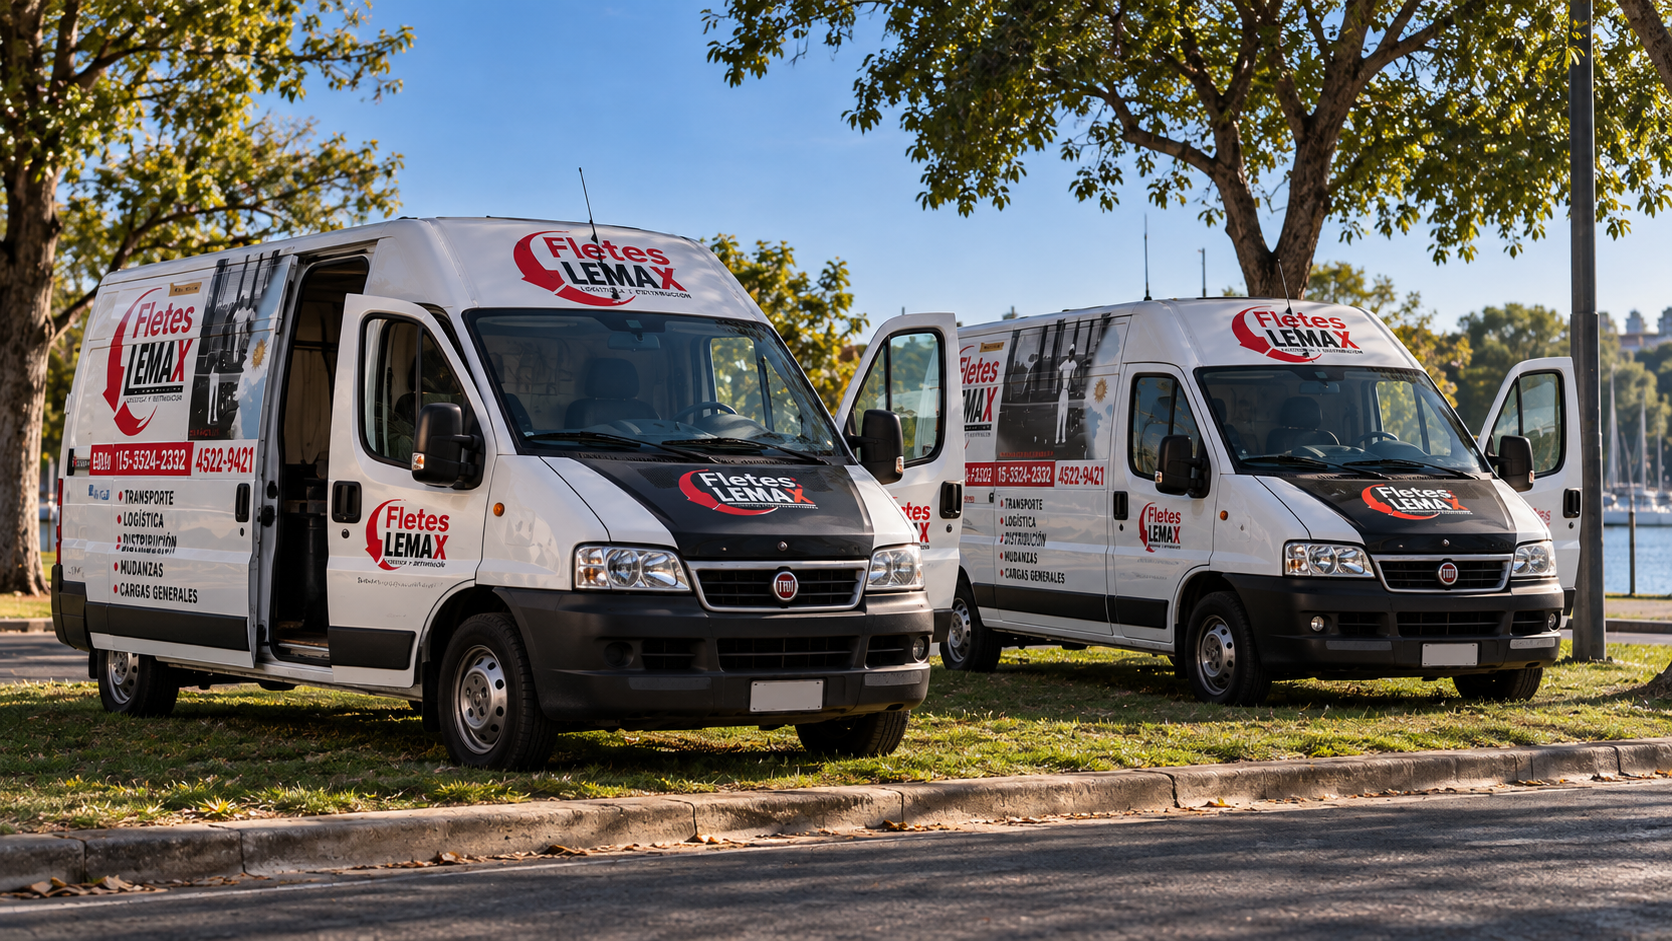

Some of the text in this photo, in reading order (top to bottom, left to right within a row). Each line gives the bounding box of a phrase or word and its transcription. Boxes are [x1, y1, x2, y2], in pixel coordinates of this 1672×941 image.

[542, 236, 670, 266] Fletes
[560, 261, 688, 292] LEMAX
[132, 301, 195, 339] Fletes
[1252, 311, 1346, 329] Fletes
[1265, 329, 1360, 350] LEMAX
[124, 339, 193, 396] LEMAX
[962, 386, 999, 428] MAX
[698, 472, 796, 488] Fletes
[125, 489, 175, 505] TRANSPORTE
[711, 486, 815, 505] LEMAX
[1375, 486, 1452, 498] Fletes
[1005, 497, 1043, 510] TRANSPORTE
[1387, 497, 1469, 510] LEMAX
[123, 509, 164, 528] LOGÍSTICA
[386, 505, 450, 532] Fletes
[1148, 506, 1181, 524] Fletes
[1148, 525, 1181, 544] LEMAX
[384, 531, 449, 560] LEMAX
[1004, 550, 1038, 565] MUDANZAS
[120, 560, 164, 578] MUDANZAS
[119, 582, 198, 604] CARGAS GENERALES
